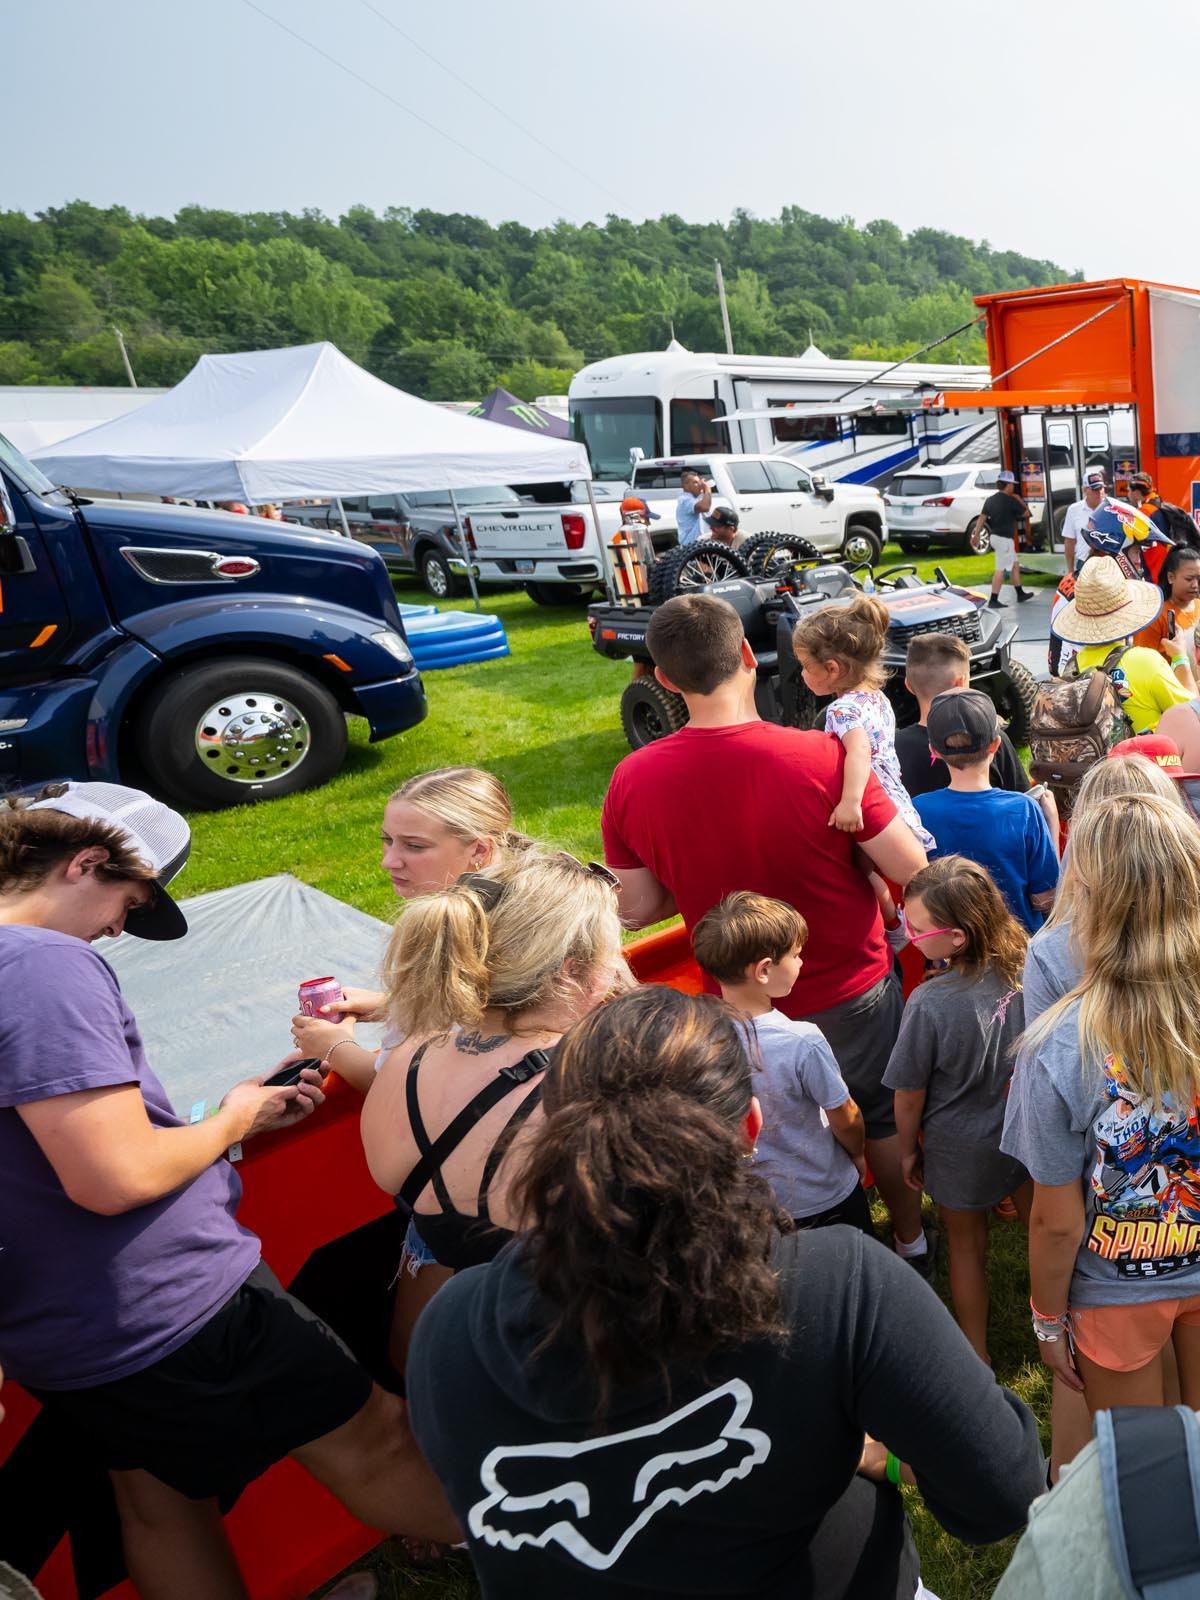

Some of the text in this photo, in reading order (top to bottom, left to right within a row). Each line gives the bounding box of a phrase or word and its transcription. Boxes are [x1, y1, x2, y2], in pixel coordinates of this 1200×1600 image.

[476, 524, 554, 533] CHEVROLET
[814, 570, 839, 579] POLARIS
[712, 584, 741, 594] POLARIS
[617, 633, 645, 641] FACTORY
[1113, 1115, 1148, 1145] THOR
[1125, 1208, 1156, 1219] 2024
